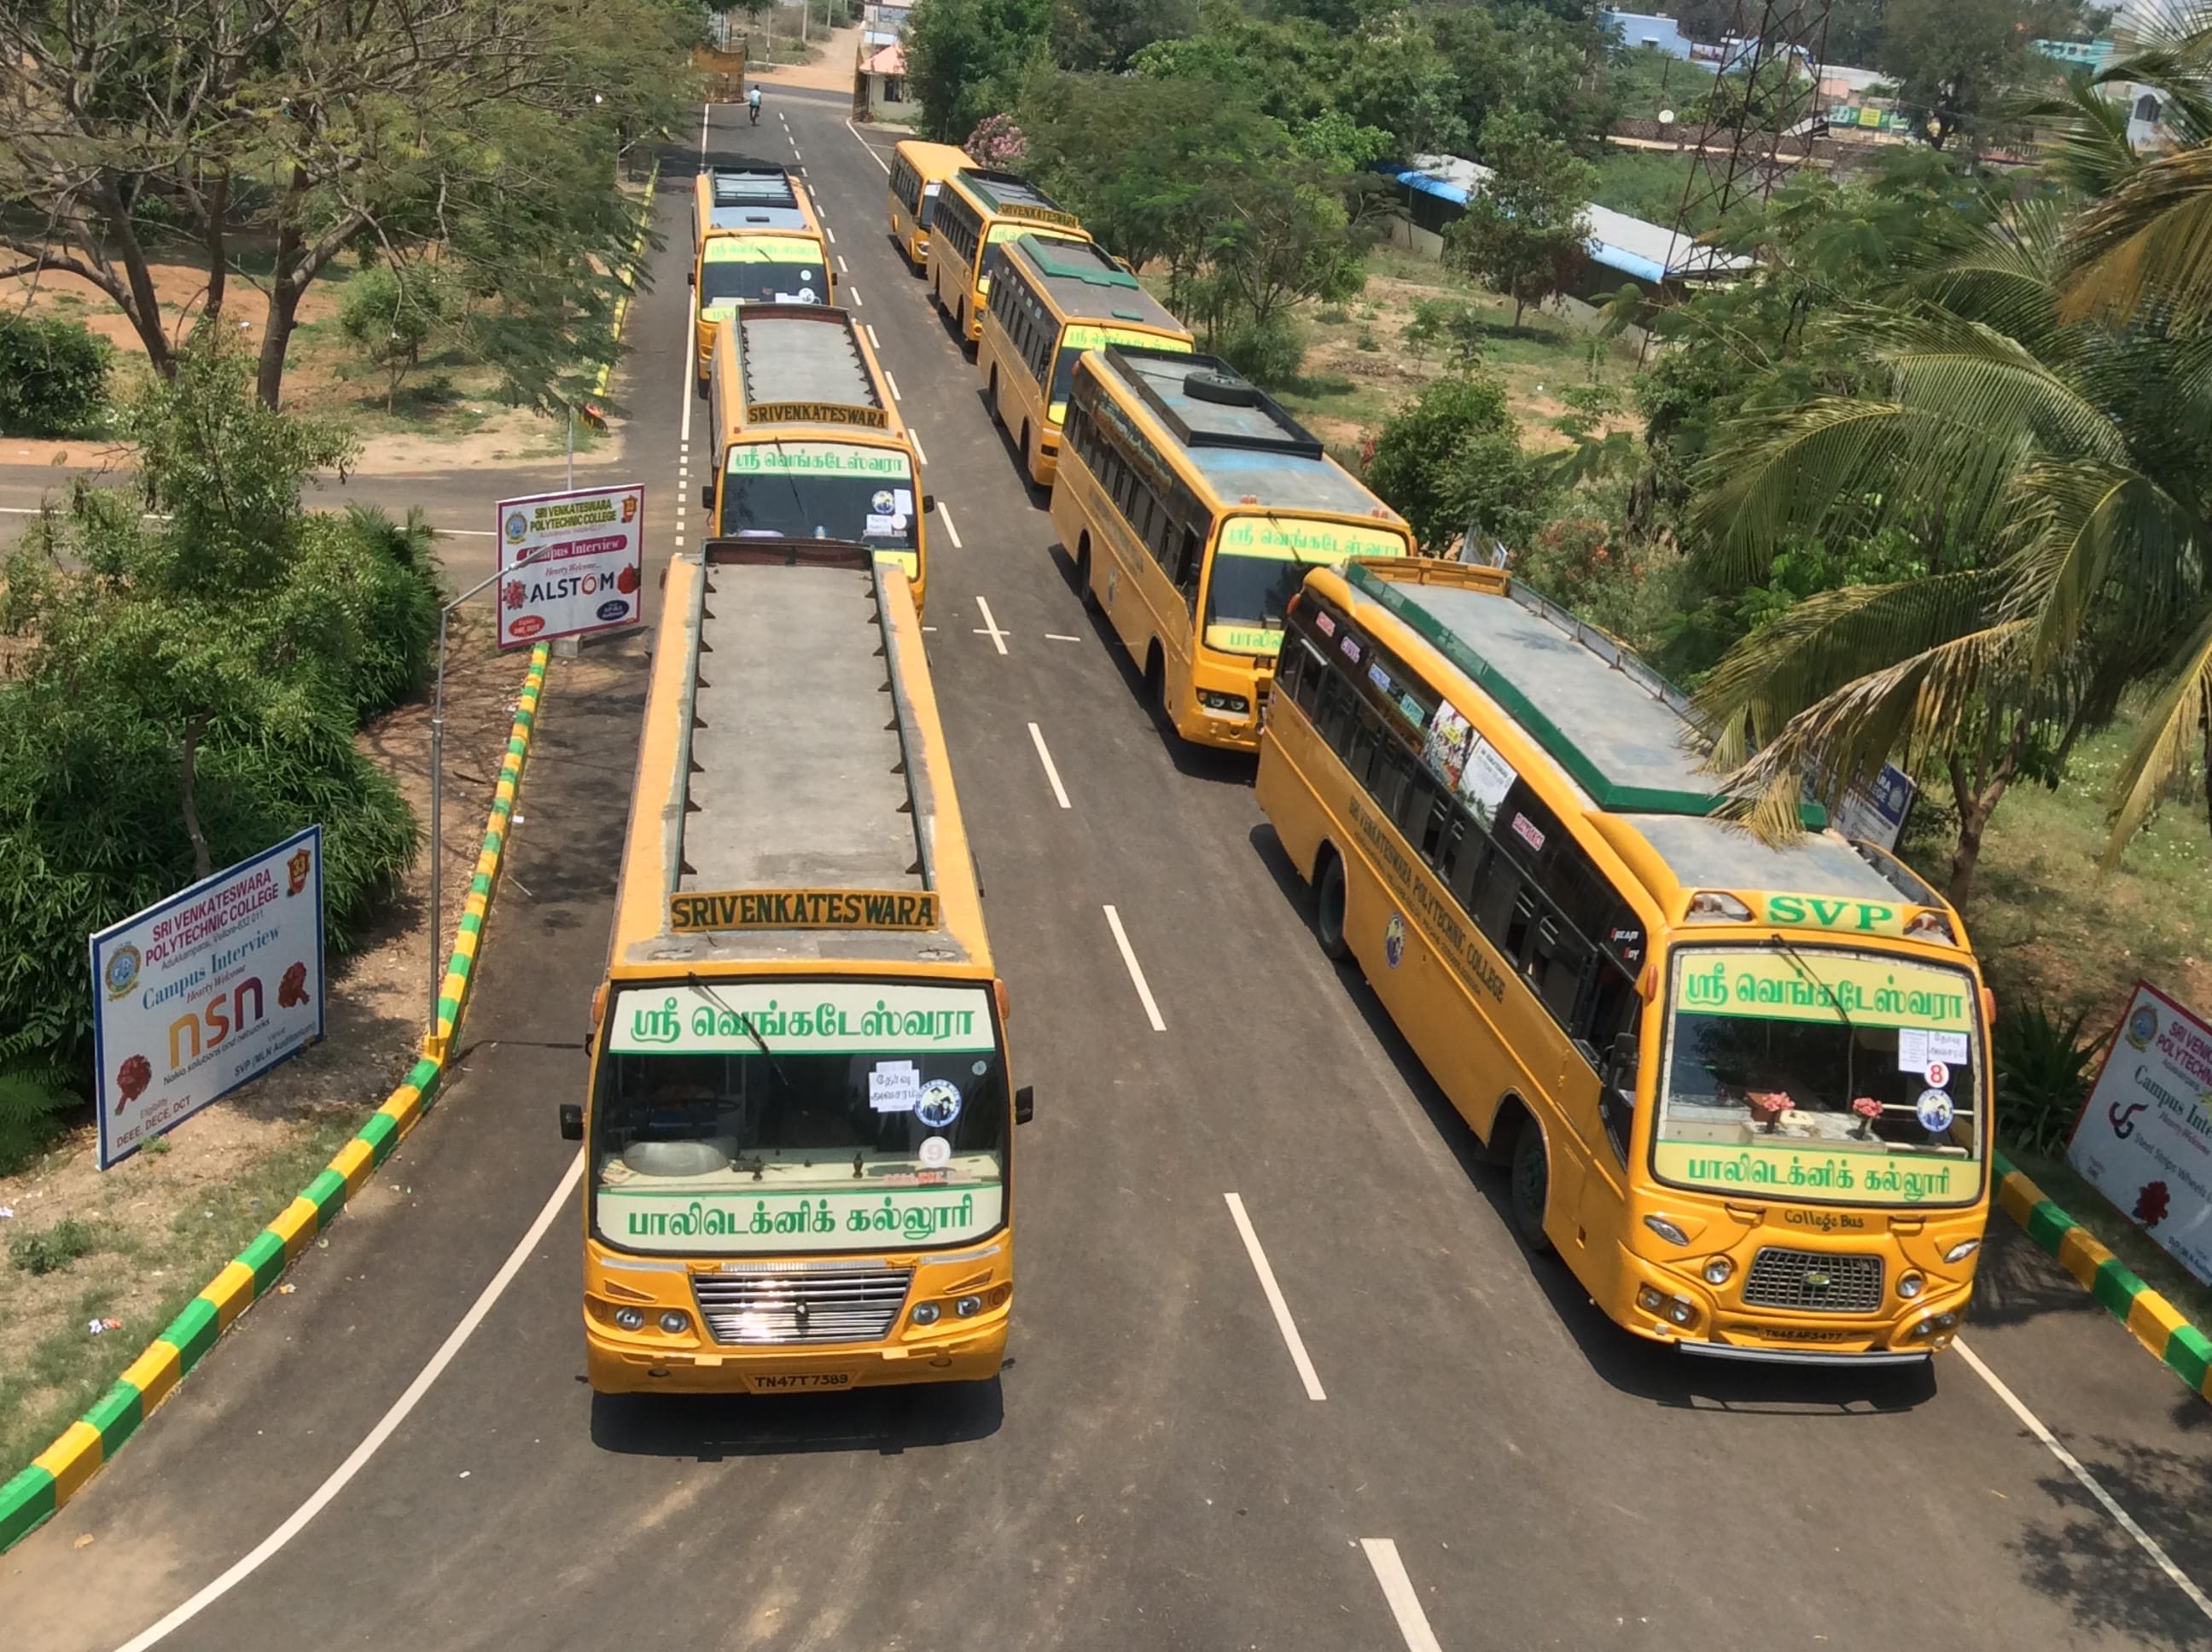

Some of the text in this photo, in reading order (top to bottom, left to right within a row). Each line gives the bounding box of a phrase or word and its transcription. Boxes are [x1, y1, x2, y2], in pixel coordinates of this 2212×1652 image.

[749, 405, 886, 428] SRIVENKATESWARA
[530, 515, 582, 532] POLYTECHNIC
[583, 510, 617, 524] COLLEGE
[548, 498, 612, 517] VENKATESWARA
[527, 538, 620, 561] Cpus Interview
[530, 572, 614, 603] ALSTOM
[153, 869, 271, 943] SRI VENKATESWARA
[671, 892, 936, 928] SRIVENKATESWARA
[1768, 895, 1894, 931] SVP
[145, 883, 279, 968] POLYTECHNIC COLLEGE
[143, 926, 281, 1010] Campus Interview
[1685, 962, 1730, 1007] ஸ்ரீ
[170, 976, 265, 1070] nsn
[630, 996, 681, 1044] ஸ்ரீ
[1930, 1064, 1942, 1083] 8
[2134, 1065, 2184, 1116] Campus
[927, 1144, 943, 1160] 9
[1864, 1161, 1951, 1202] கல்லூரி
[628, 1194, 974, 1241] பாலிடெக்னிக் கல்லூரி
[1784, 1209, 1865, 1231] College Bus
